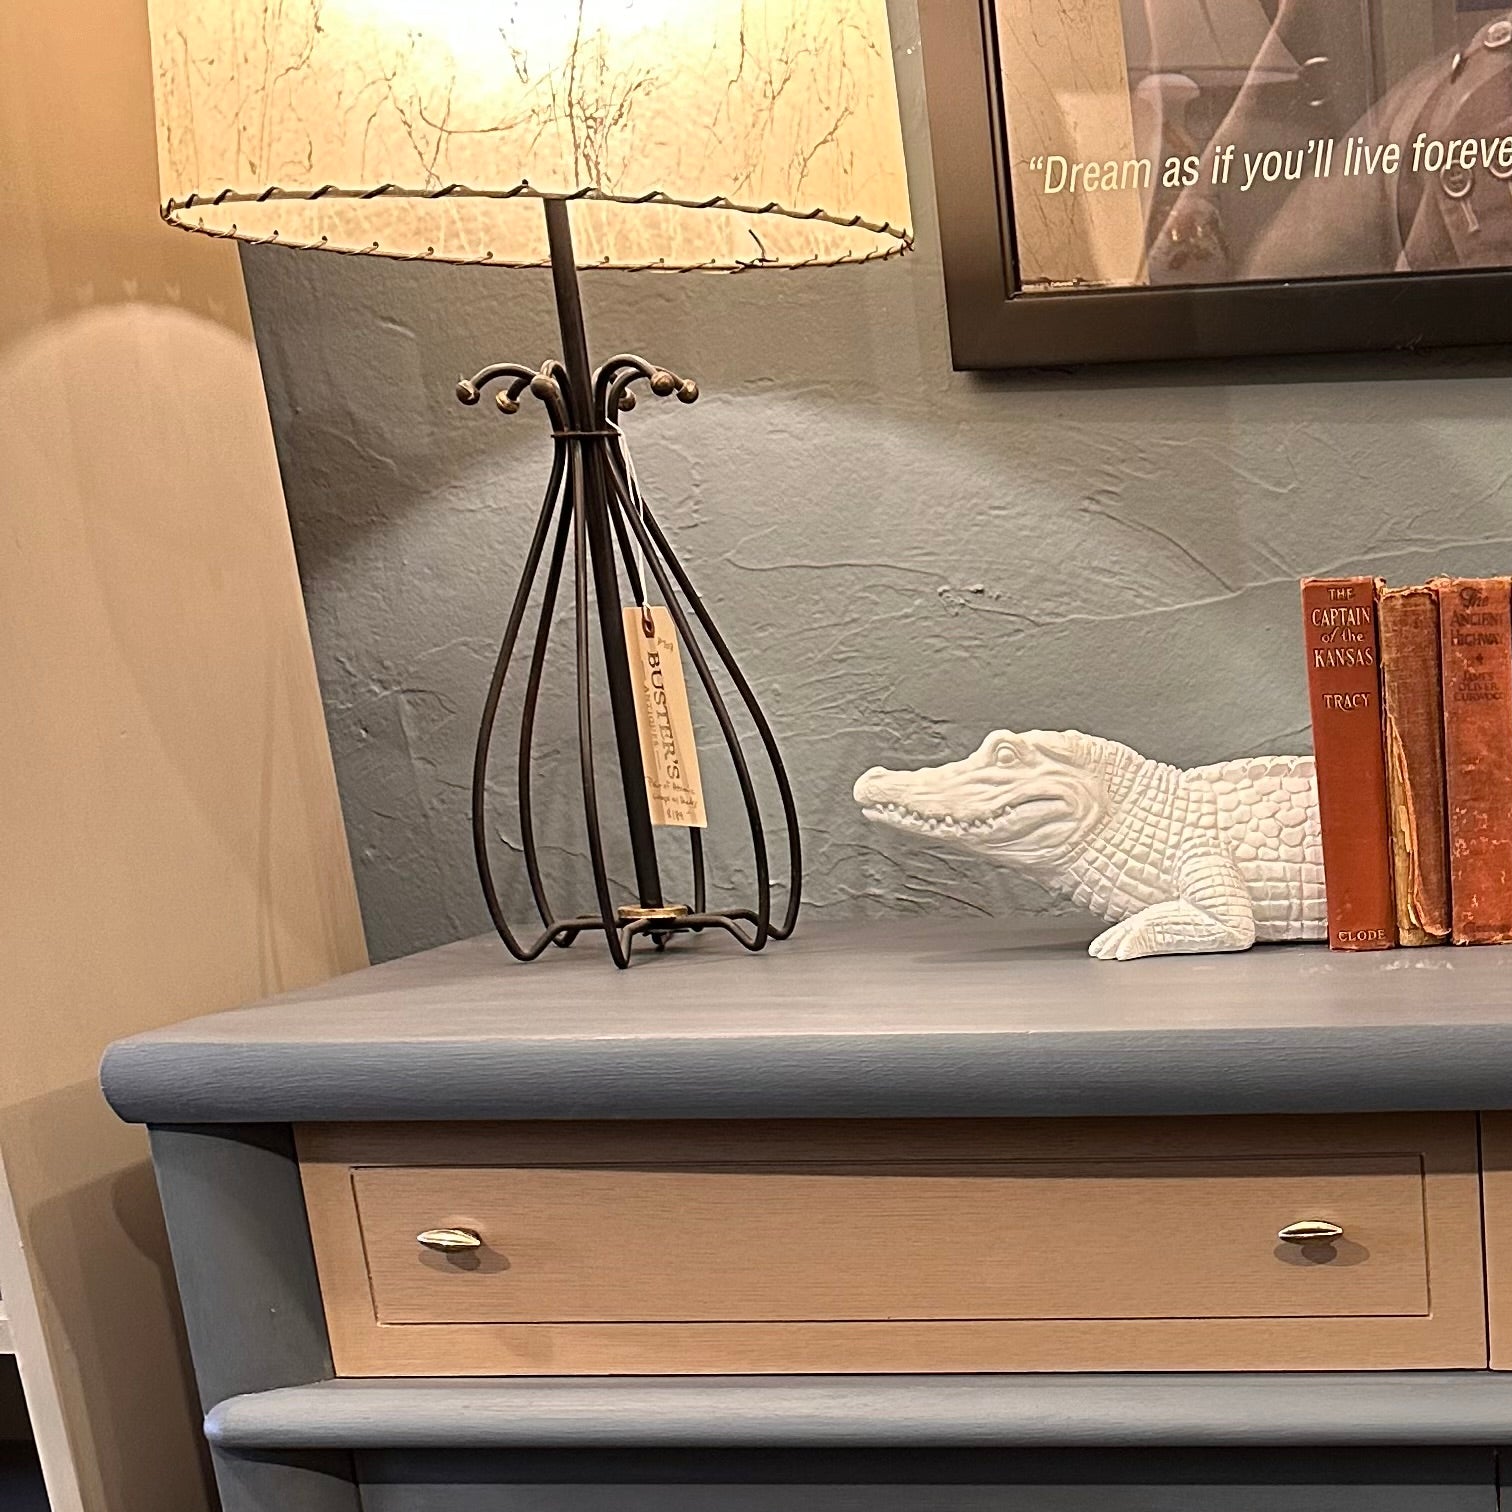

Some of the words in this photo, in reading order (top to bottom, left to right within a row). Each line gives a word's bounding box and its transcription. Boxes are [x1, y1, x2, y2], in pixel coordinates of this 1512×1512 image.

[1029, 155, 1151, 194] “Dream
[1162, 155, 1200, 187] as
[1211, 144, 1236, 185] if
[1240, 138, 1334, 192] you’ll
[1343, 136, 1400, 176] live
[1328, 587, 1354, 601] THE
[1312, 607, 1371, 627] CAPTAIN
[1321, 626, 1340, 643] of
[1341, 627, 1364, 642] the
[1313, 647, 1373, 668] KANSAS
[1323, 693, 1371, 712] TRACY
[1338, 929, 1386, 942] CLODE
